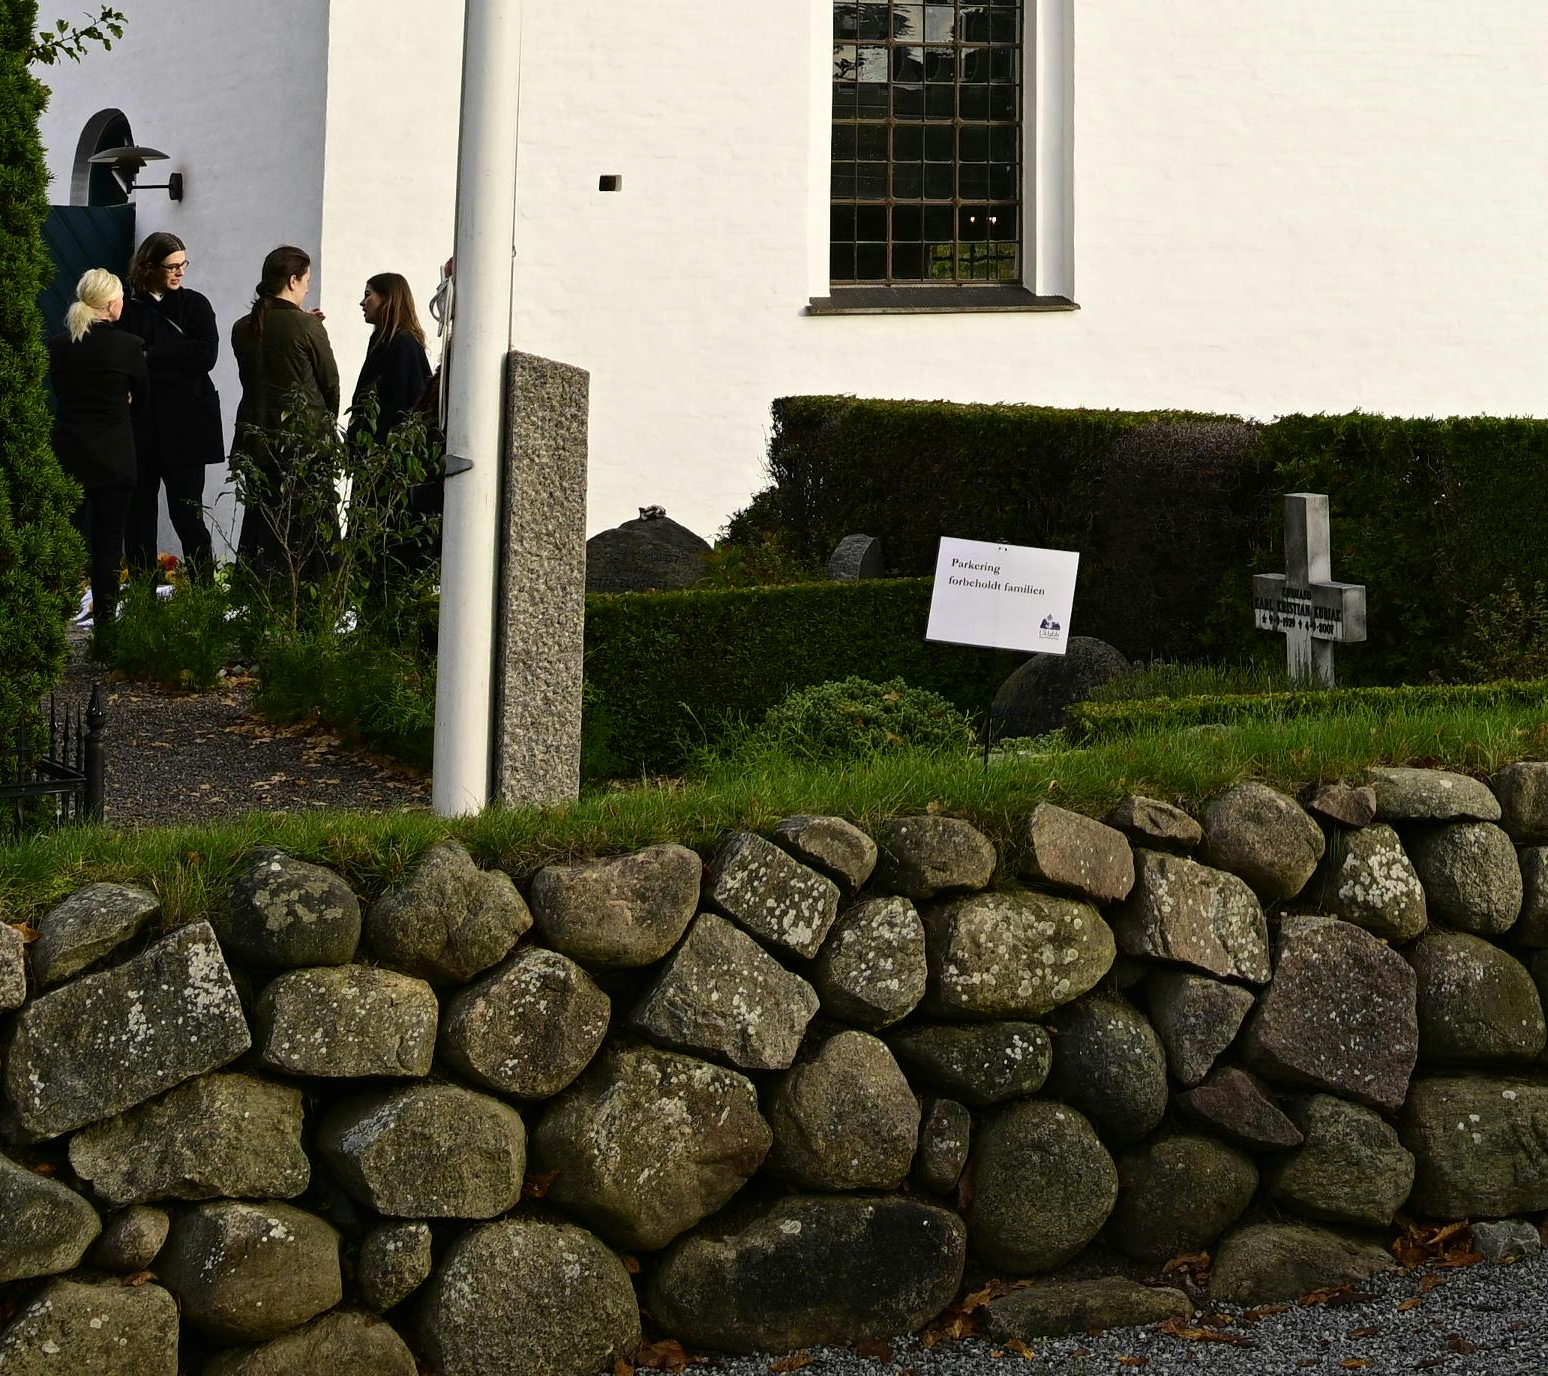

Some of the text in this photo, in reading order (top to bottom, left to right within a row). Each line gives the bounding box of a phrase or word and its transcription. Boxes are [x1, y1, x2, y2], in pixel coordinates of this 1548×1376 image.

[951, 558, 1001, 575] Parkering
[948, 576, 1045, 596] forbeholdt familien
